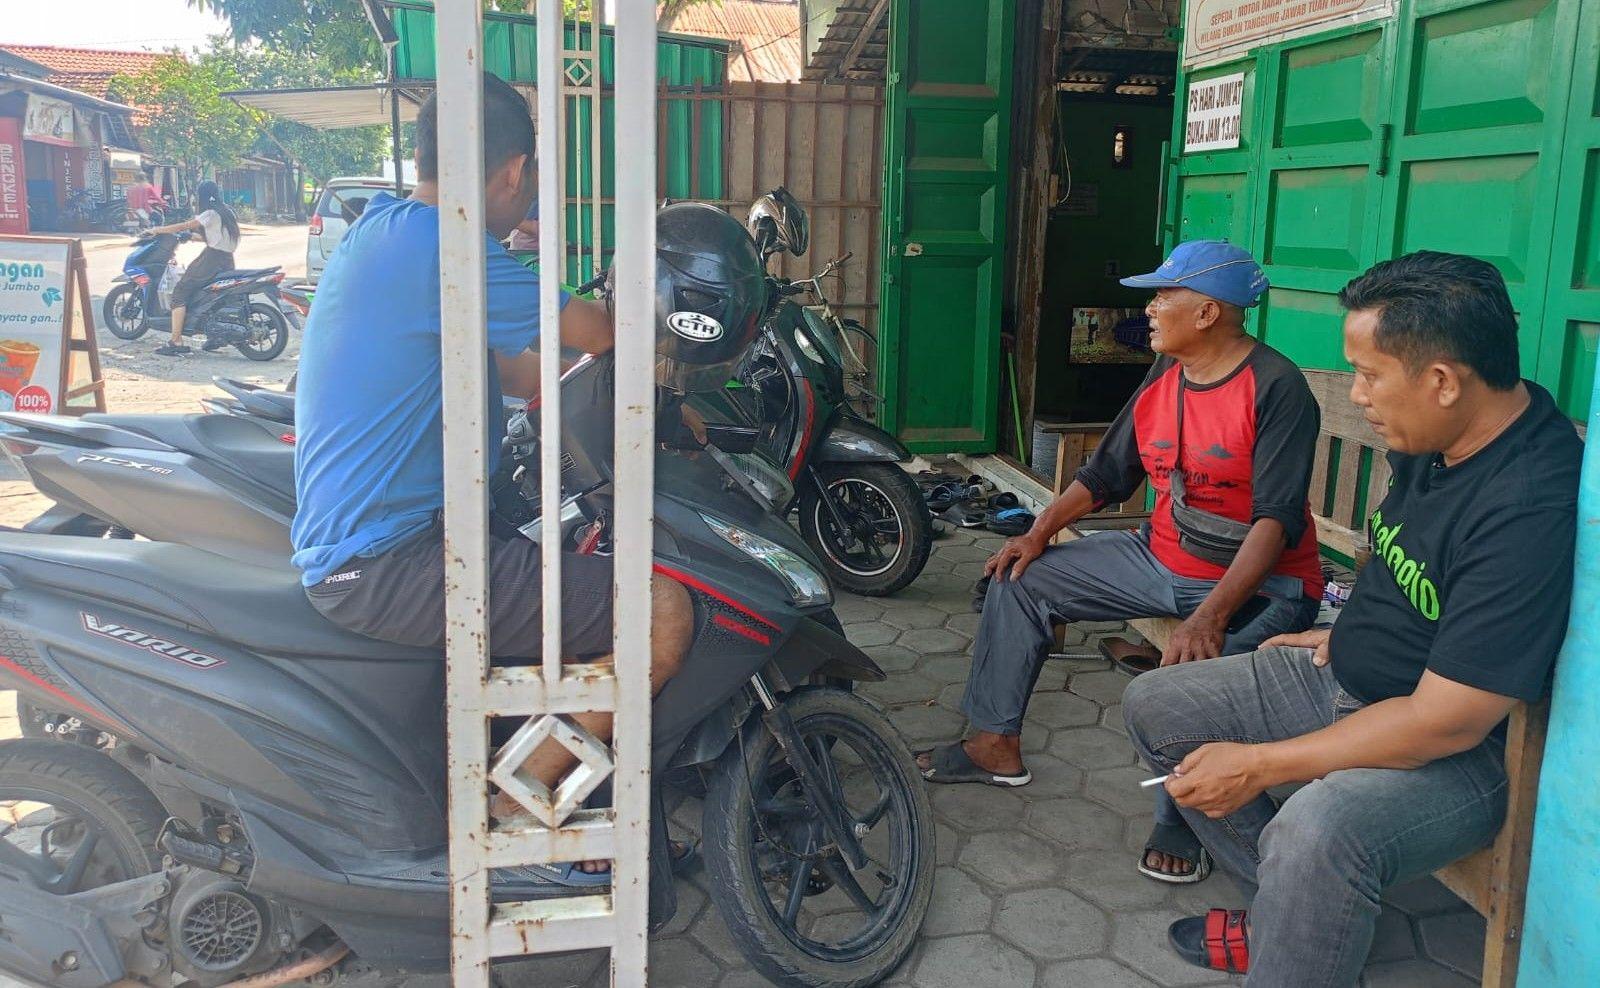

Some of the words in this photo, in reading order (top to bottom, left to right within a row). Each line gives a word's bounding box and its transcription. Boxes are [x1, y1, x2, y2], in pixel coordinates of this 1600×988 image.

[1210, 9, 1233, 26] SEPEDA
[1244, 11, 1280, 32] TANGGUNG
[1280, 3, 1307, 21] JAWAB
[1189, 89, 1199, 113] PS
[1198, 85, 1216, 111] HARI
[1186, 120, 1205, 144] BUKA
[1205, 117, 1221, 142] JAM
[3, 281, 40, 291] Jumbo
[0, 313, 28, 323] yata
[19, 393, 49, 407] 100%
[81, 612, 224, 668] VARIO
